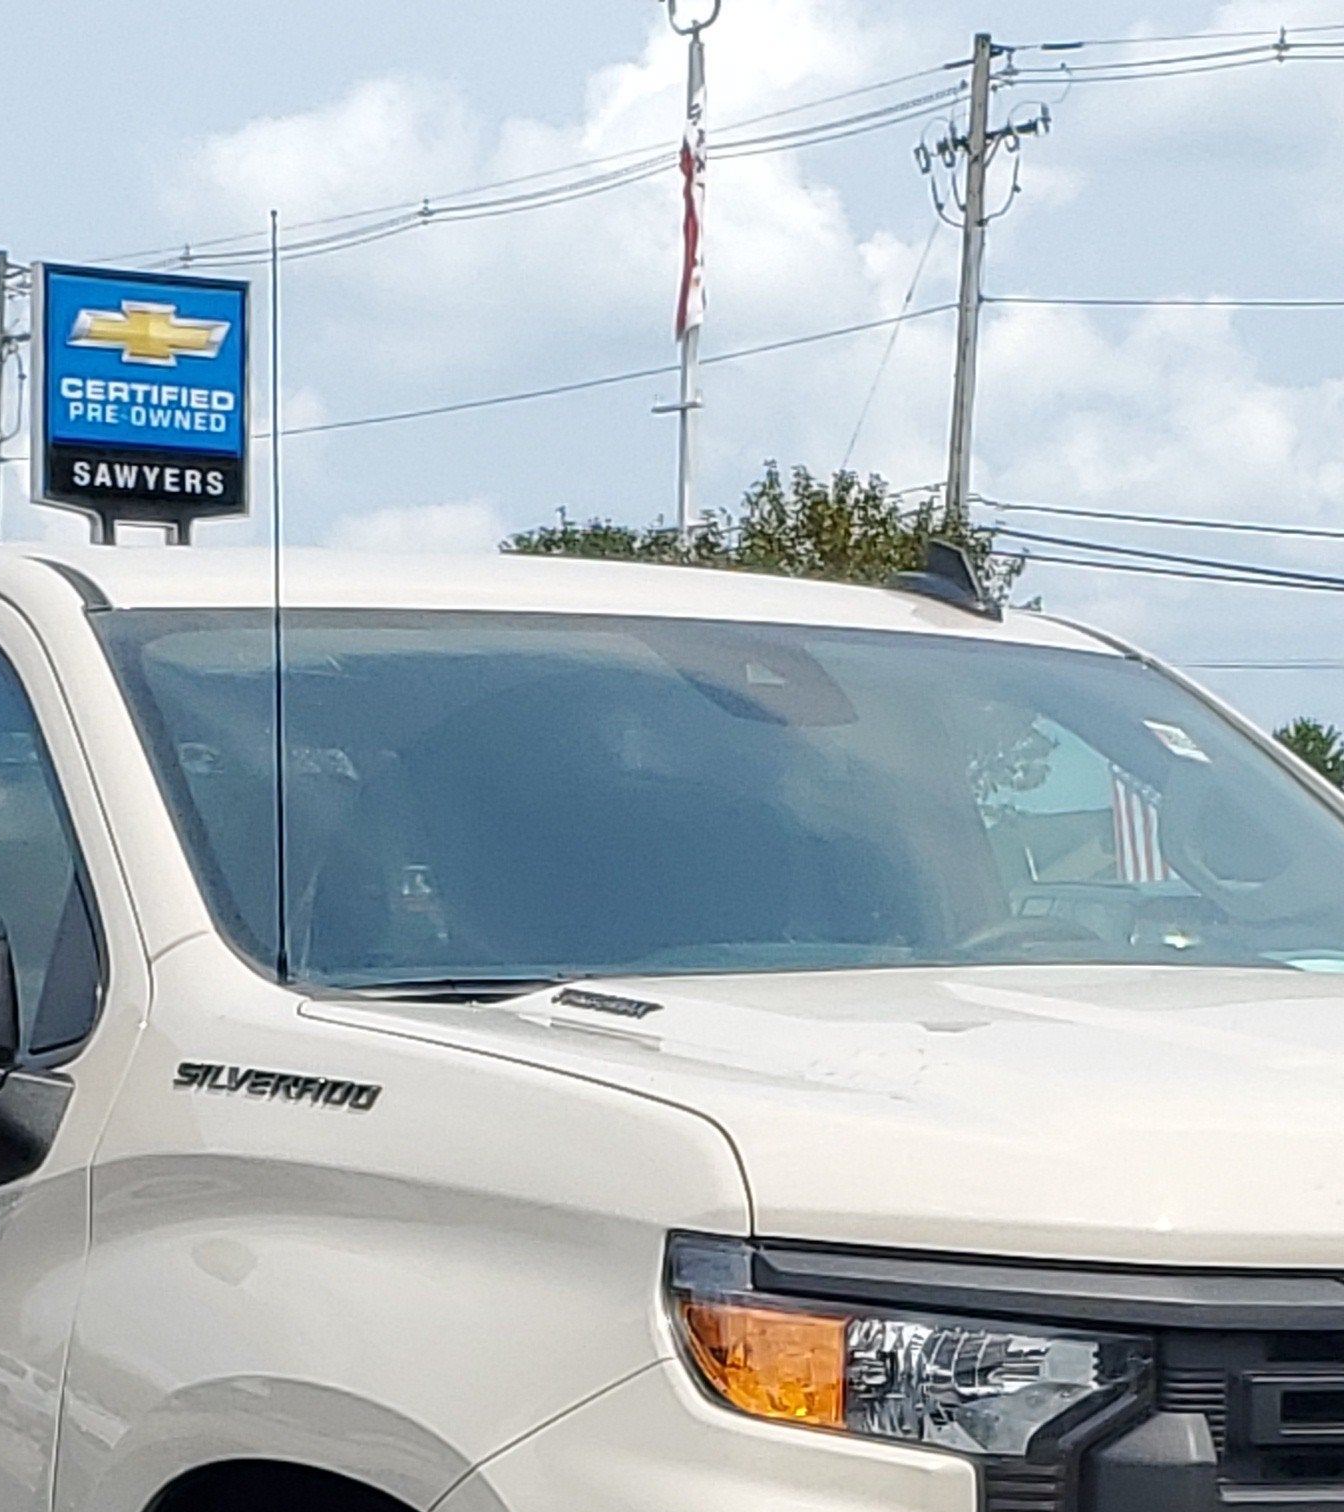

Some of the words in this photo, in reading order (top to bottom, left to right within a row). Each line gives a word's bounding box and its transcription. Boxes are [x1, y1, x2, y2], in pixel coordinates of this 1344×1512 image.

[61, 377, 235, 411] CERTIFIED
[73, 461, 224, 495] SAWYERS
[173, 1062, 383, 1111] SILVERADO
